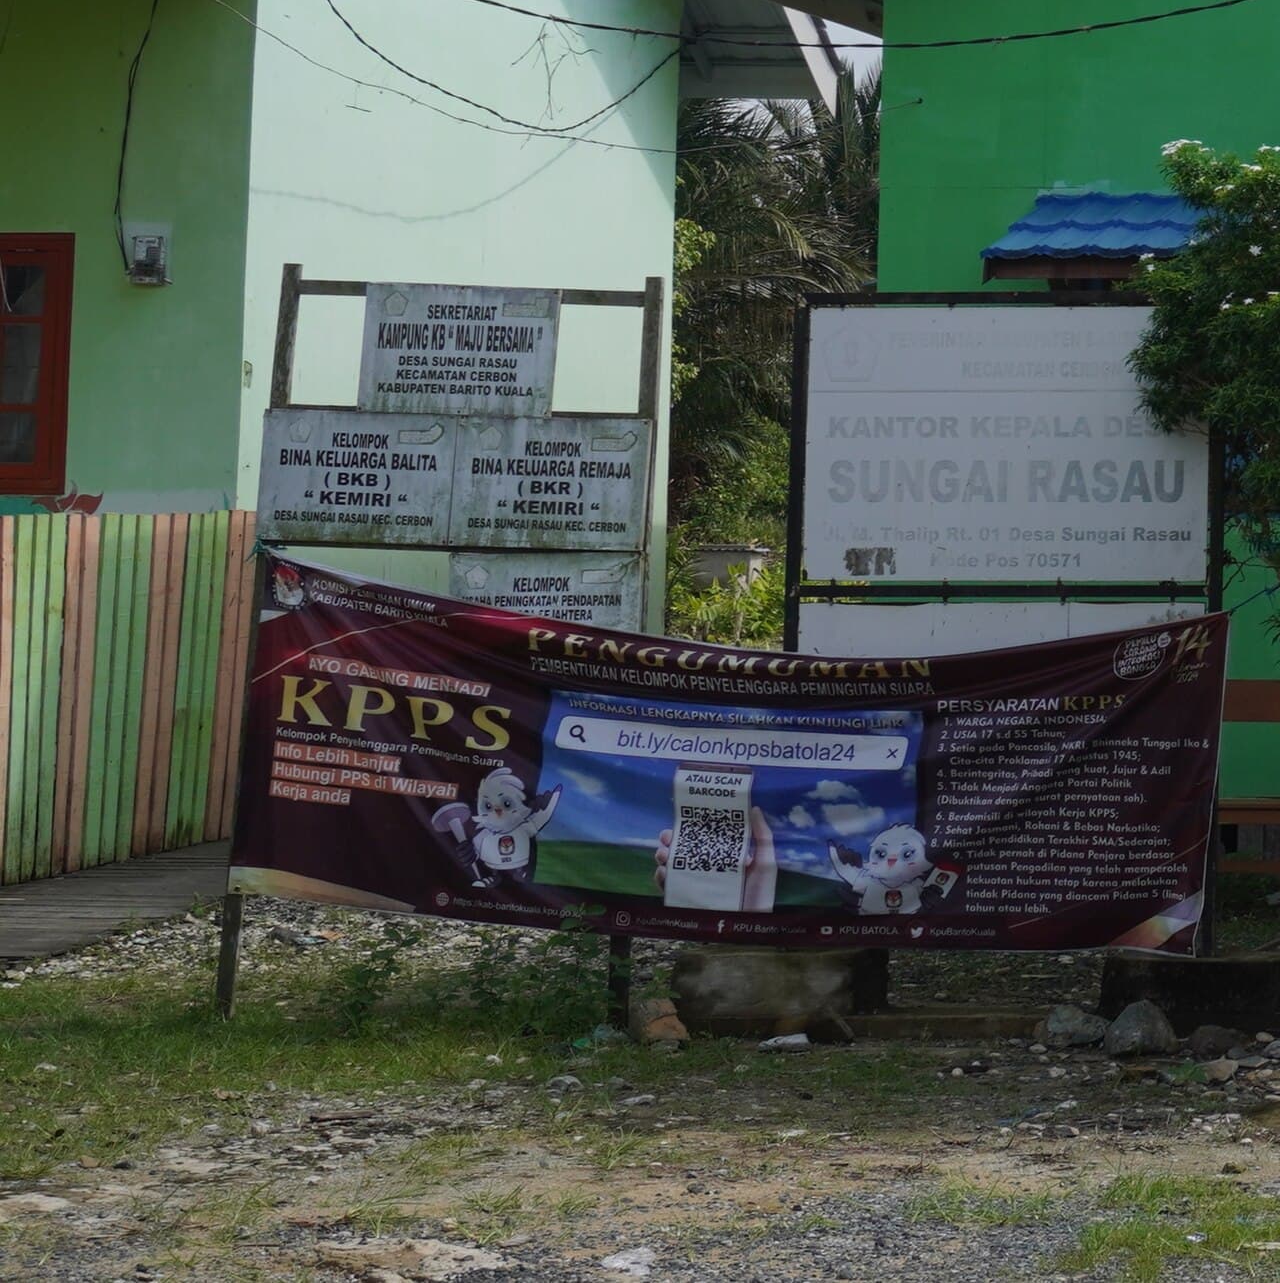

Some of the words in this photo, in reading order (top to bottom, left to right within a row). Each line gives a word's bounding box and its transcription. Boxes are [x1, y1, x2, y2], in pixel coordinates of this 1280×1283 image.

[428, 305, 497, 320] SEKRETARIAT
[378, 323, 428, 349] KAMPUNG
[431, 325, 445, 350] KB
[398, 356, 428, 366] DESA
[432, 357, 475, 367] SUNGAI
[480, 358, 517, 368] RASAU
[396, 370, 465, 380] KECAMATAN
[470, 372, 517, 382] CERBON
[378, 383, 445, 393] KABUPATEN
[450, 384, 490, 395] BARITO
[495, 386, 533, 396] KUALA
[828, 416, 959, 438] KANTOR
[970, 416, 1093, 438] KEPALA
[332, 432, 389, 449] KELOMPOK
[525, 441, 581, 457] KELOMPOK
[280, 449, 311, 466] BINA
[316, 450, 386, 469] KELUARGA
[391, 454, 437, 471] BALITA
[472, 458, 502, 475] BINA
[507, 459, 575, 477] KELUARGA
[579, 462, 631, 478] REMAJA
[827, 460, 1008, 502] SUNGAI
[1027, 460, 1185, 502] RASAU
[274, 510, 298, 520] DESA
[301, 511, 335, 522] SUNGAI
[338, 513, 369, 523] RASAU
[371, 514, 392, 525] KEC.
[395, 516, 432, 526] CERBON
[468, 518, 491, 528] DESA
[494, 519, 528, 530] SUNGAI
[532, 520, 562, 531] RASAU
[565, 520, 585, 531] KEC.
[589, 522, 626, 532] CERBON
[947, 527, 971, 541] Rt.
[979, 527, 1000, 541] 01
[1009, 527, 1054, 541] Desa
[1062, 527, 1125, 544] Sungai
[1133, 527, 1191, 541] Rasau
[986, 554, 1018, 567] Pos
[1027, 553, 1081, 567] 70571
[513, 577, 570, 592] KELOMPOK
[309, 591, 373, 612] KABUPATEN
[312, 579, 349, 593] KOMISI
[404, 600, 436, 612] UMUM
[495, 595, 557, 606] PENINGKATAN
[561, 595, 622, 606] PENDAPATAN
[527, 627, 932, 679] PENGUMUMAN
[309, 658, 341, 673] AYO
[414, 675, 490, 697] MENJADI
[531, 657, 618, 680] PEMBENTUKAN
[621, 669, 687, 689] KELOMPOK
[690, 675, 798, 695] PENYELENGGARA
[801, 682, 886, 696] PEMUNGUTAN
[890, 682, 935, 694] SUARA
[937, 698, 1059, 713] PERSYARATAN
[1063, 694, 1126, 711] KPPS
[276, 675, 512, 751] KPPS
[569, 699, 637, 715] INFORMASI
[641, 708, 723, 722] LENGKAPNYA
[728, 713, 793, 726] SILAHKAN
[797, 716, 866, 728] KUNJUNGI
[871, 719, 903, 727] LINK
[957, 718, 993, 726] WARGA
[997, 717, 1040, 726] NEGARA
[982, 730, 993, 738] 17
[276, 727, 326, 742] Kelompok
[330, 733, 407, 753] Penyelenggara
[410, 744, 470, 763] Pemungutan
[472, 755, 504, 767] Suara
[617, 729, 856, 761] bit.ly/calonkppsbatola24
[276, 743, 300, 759] Info
[306, 747, 349, 764] Lebih
[354, 753, 401, 772] Lanjut
[1112, 765, 1137, 775] Jujur
[275, 763, 336, 785] Hubungi
[341, 770, 370, 787] PPS
[375, 775, 386, 789] di
[391, 778, 457, 798] Wilayah
[685, 774, 711, 783] ATAU
[714, 775, 742, 785] SCAN
[952, 782, 978, 791] Tidak
[1101, 778, 1131, 788] Politik
[273, 782, 306, 801] Kerja
[312, 790, 350, 803] anda
[689, 787, 736, 797] BARCODE
[1059, 808, 1085, 818] Kerja
[945, 825, 972, 834] Sehat
[1025, 821, 1059, 830] Rohani
[839, 926, 859, 934] KPU
[862, 926, 898, 935] BATOLA
